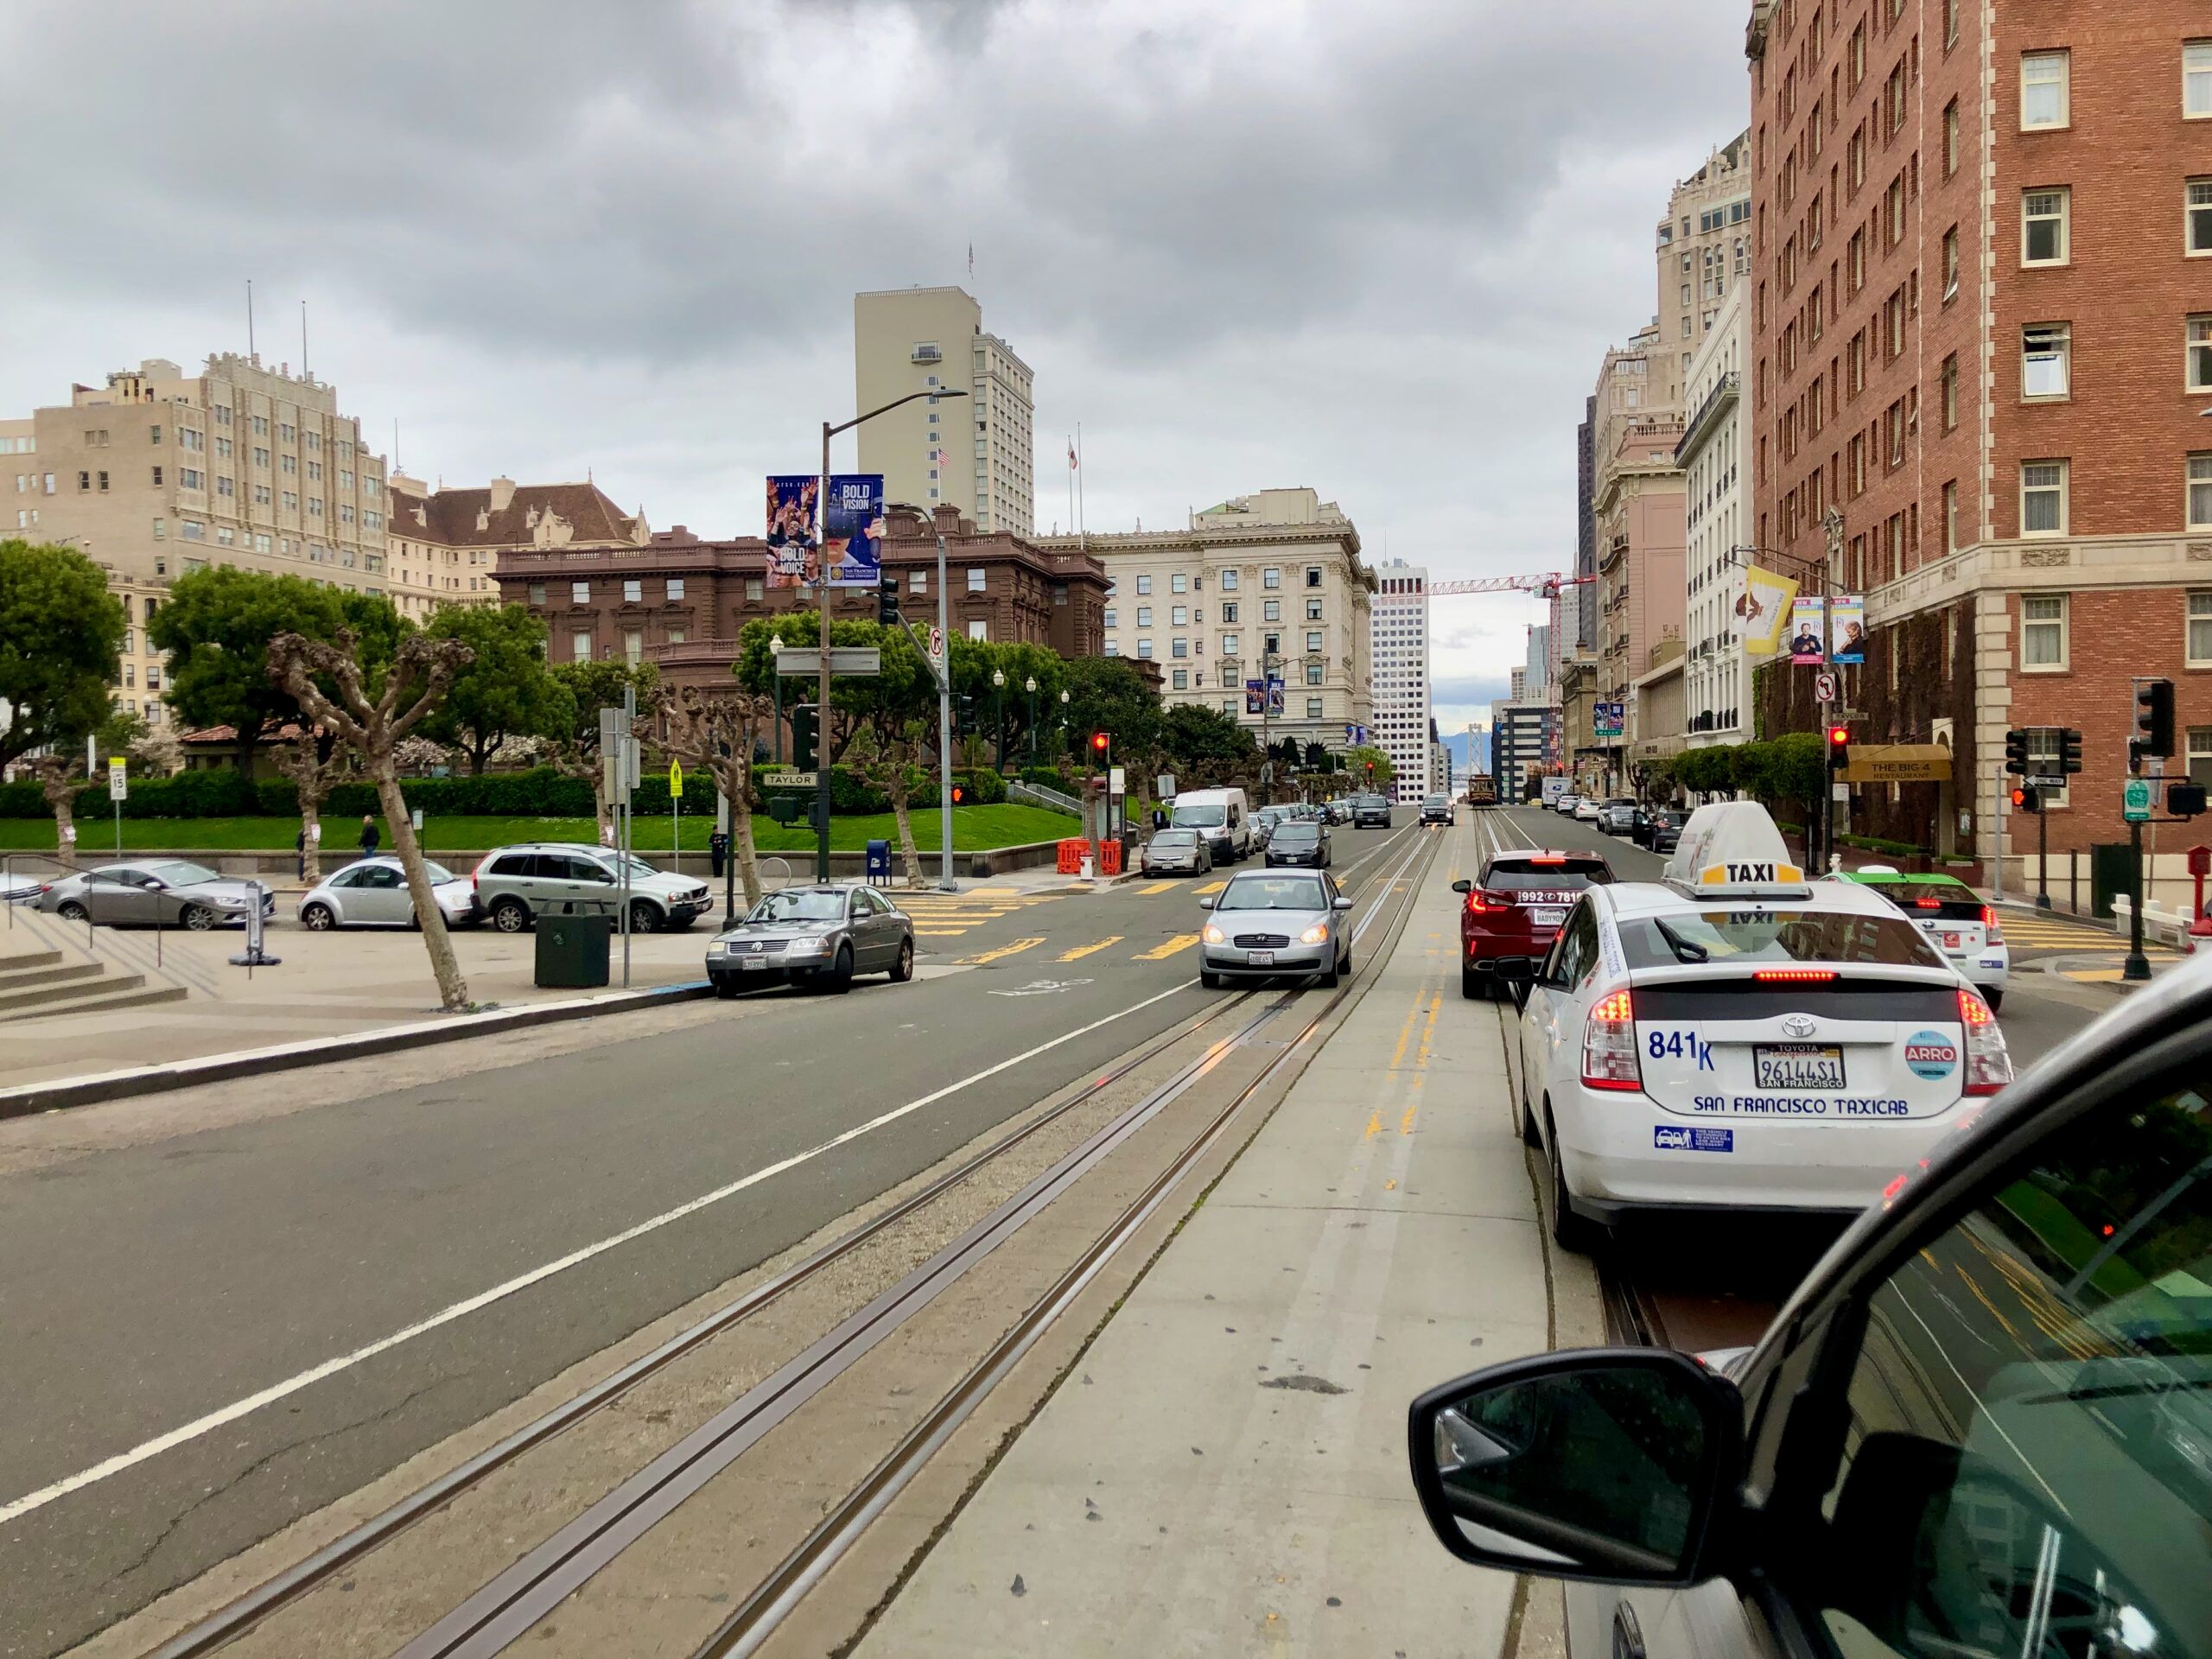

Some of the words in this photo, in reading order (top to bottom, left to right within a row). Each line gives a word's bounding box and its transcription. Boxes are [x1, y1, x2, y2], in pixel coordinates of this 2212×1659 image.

[842, 485, 870, 499] BOLD
[842, 499, 869, 511] VISION
[779, 547, 805, 562] BOLD
[780, 562, 805, 575] VOICE
[1899, 763, 1920, 772] BIG
[113, 779, 124, 788] 15
[1727, 864, 1774, 882] TAXI
[1522, 891, 1544, 901] 992
[1906, 1047, 1955, 1061] ARRO
[1783, 1080, 1844, 1089] FRANCISCO
[1694, 1096, 1725, 1111] SAN
[1733, 1096, 1827, 1114] FRANCISCO
[1834, 1099, 1909, 1116] TAXICAB
